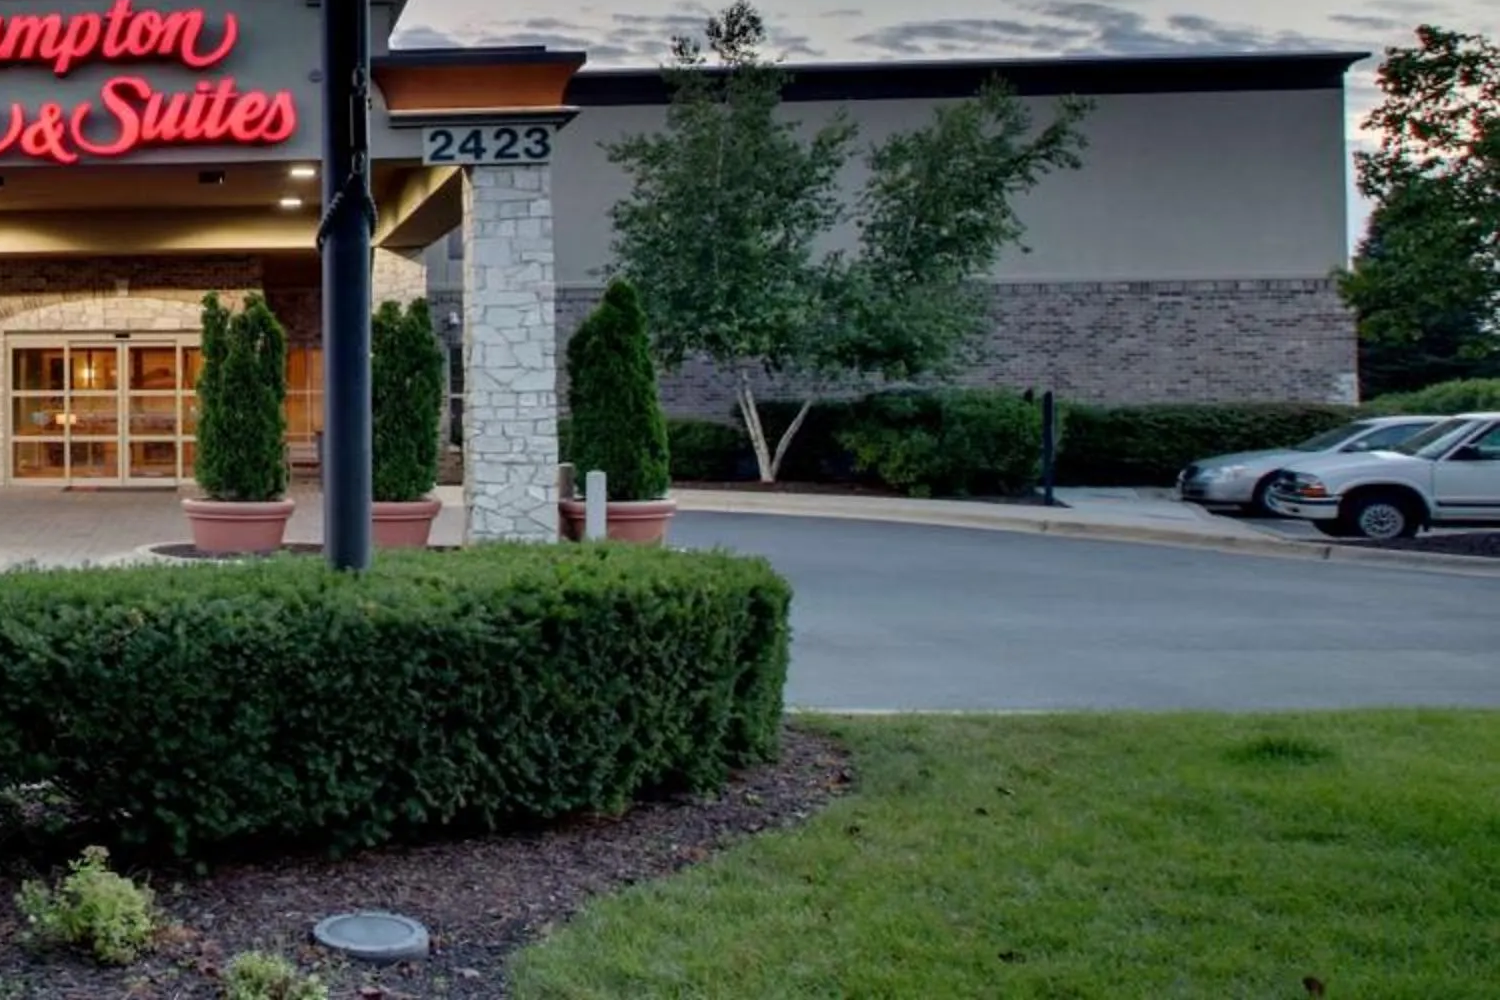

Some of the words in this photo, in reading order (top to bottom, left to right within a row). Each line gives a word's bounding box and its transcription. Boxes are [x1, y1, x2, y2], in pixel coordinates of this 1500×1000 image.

[20, 103, 80, 164] &
[70, 75, 297, 156] Suites
[429, 127, 552, 162] 2423
